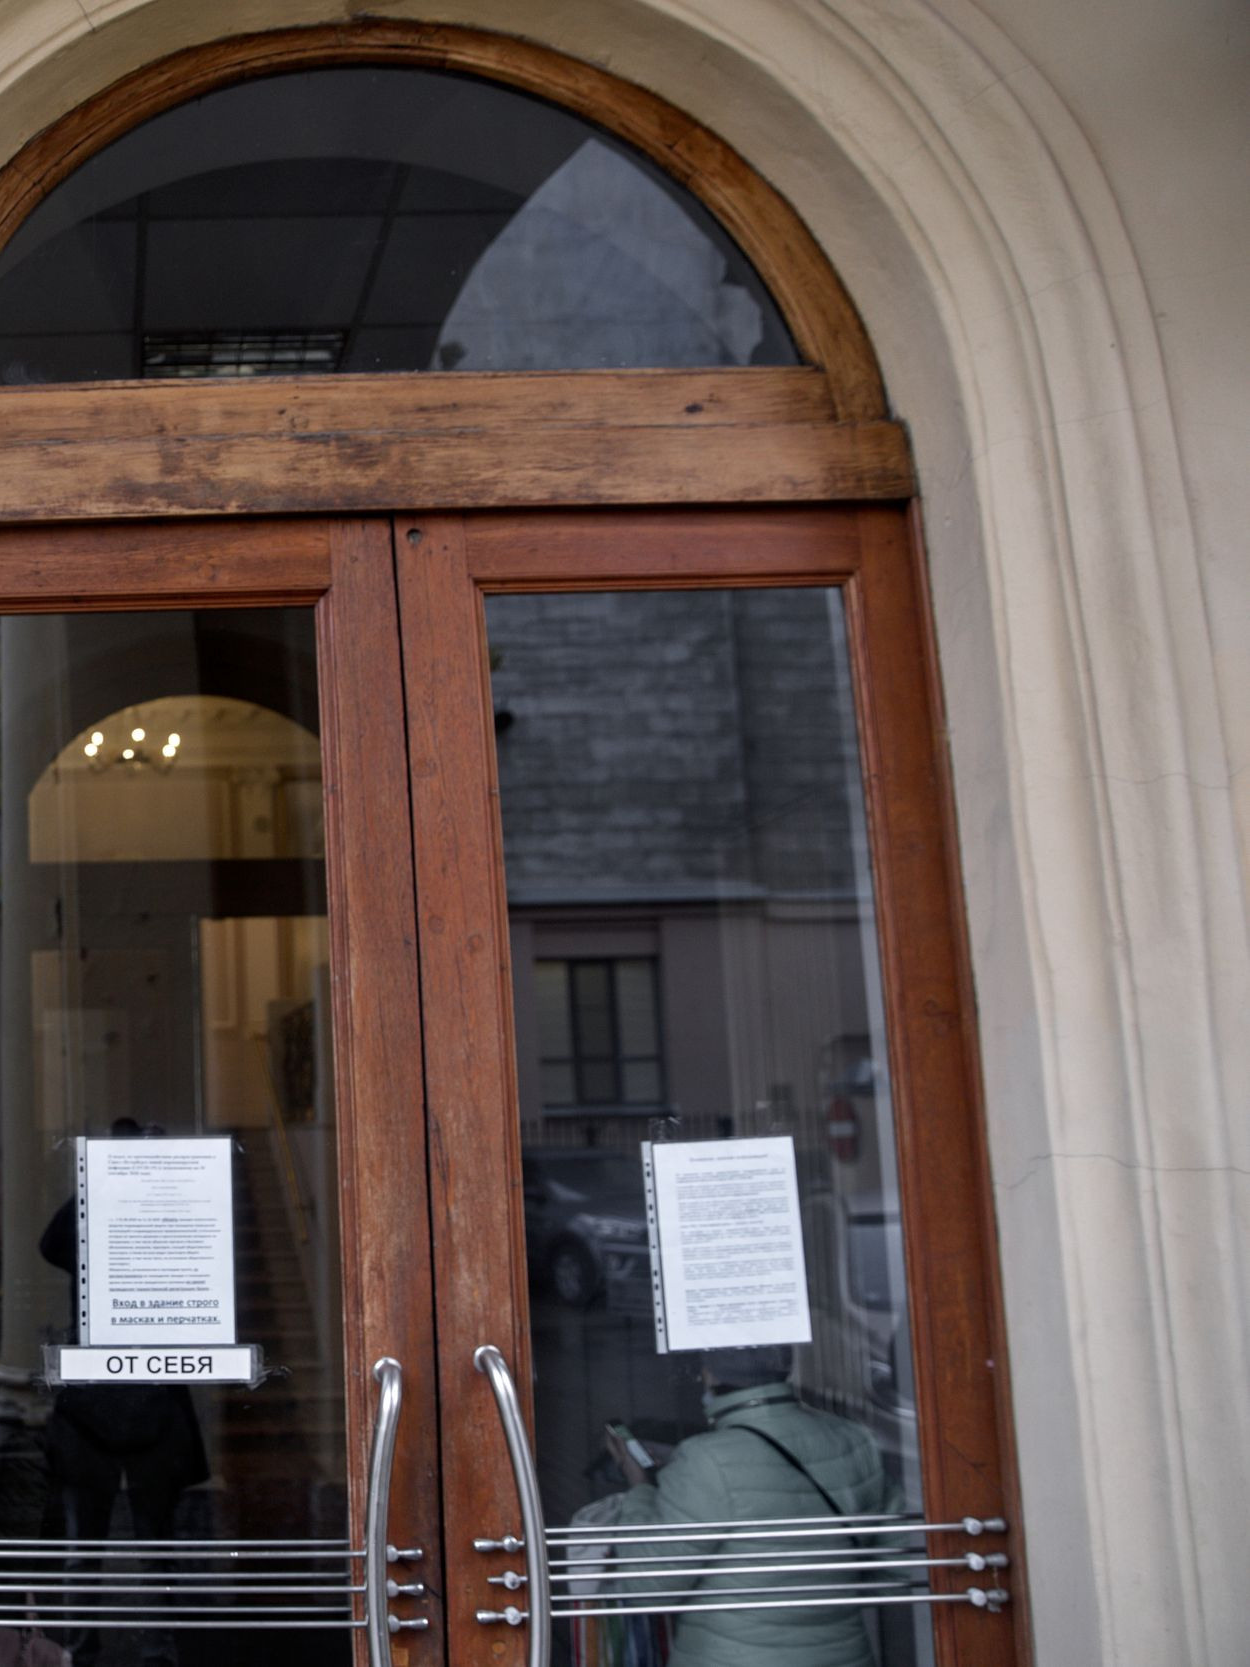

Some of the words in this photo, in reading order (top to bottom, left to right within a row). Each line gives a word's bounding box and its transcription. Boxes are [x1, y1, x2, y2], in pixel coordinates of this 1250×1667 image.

[112, 1298, 137, 1309] Вход
[149, 1300, 184, 1308] здание
[187, 1299, 219, 1308] строго
[120, 1316, 155, 1324] масках
[107, 1356, 139, 1374] ОТ
[147, 1356, 213, 1374] СЕБЯ
